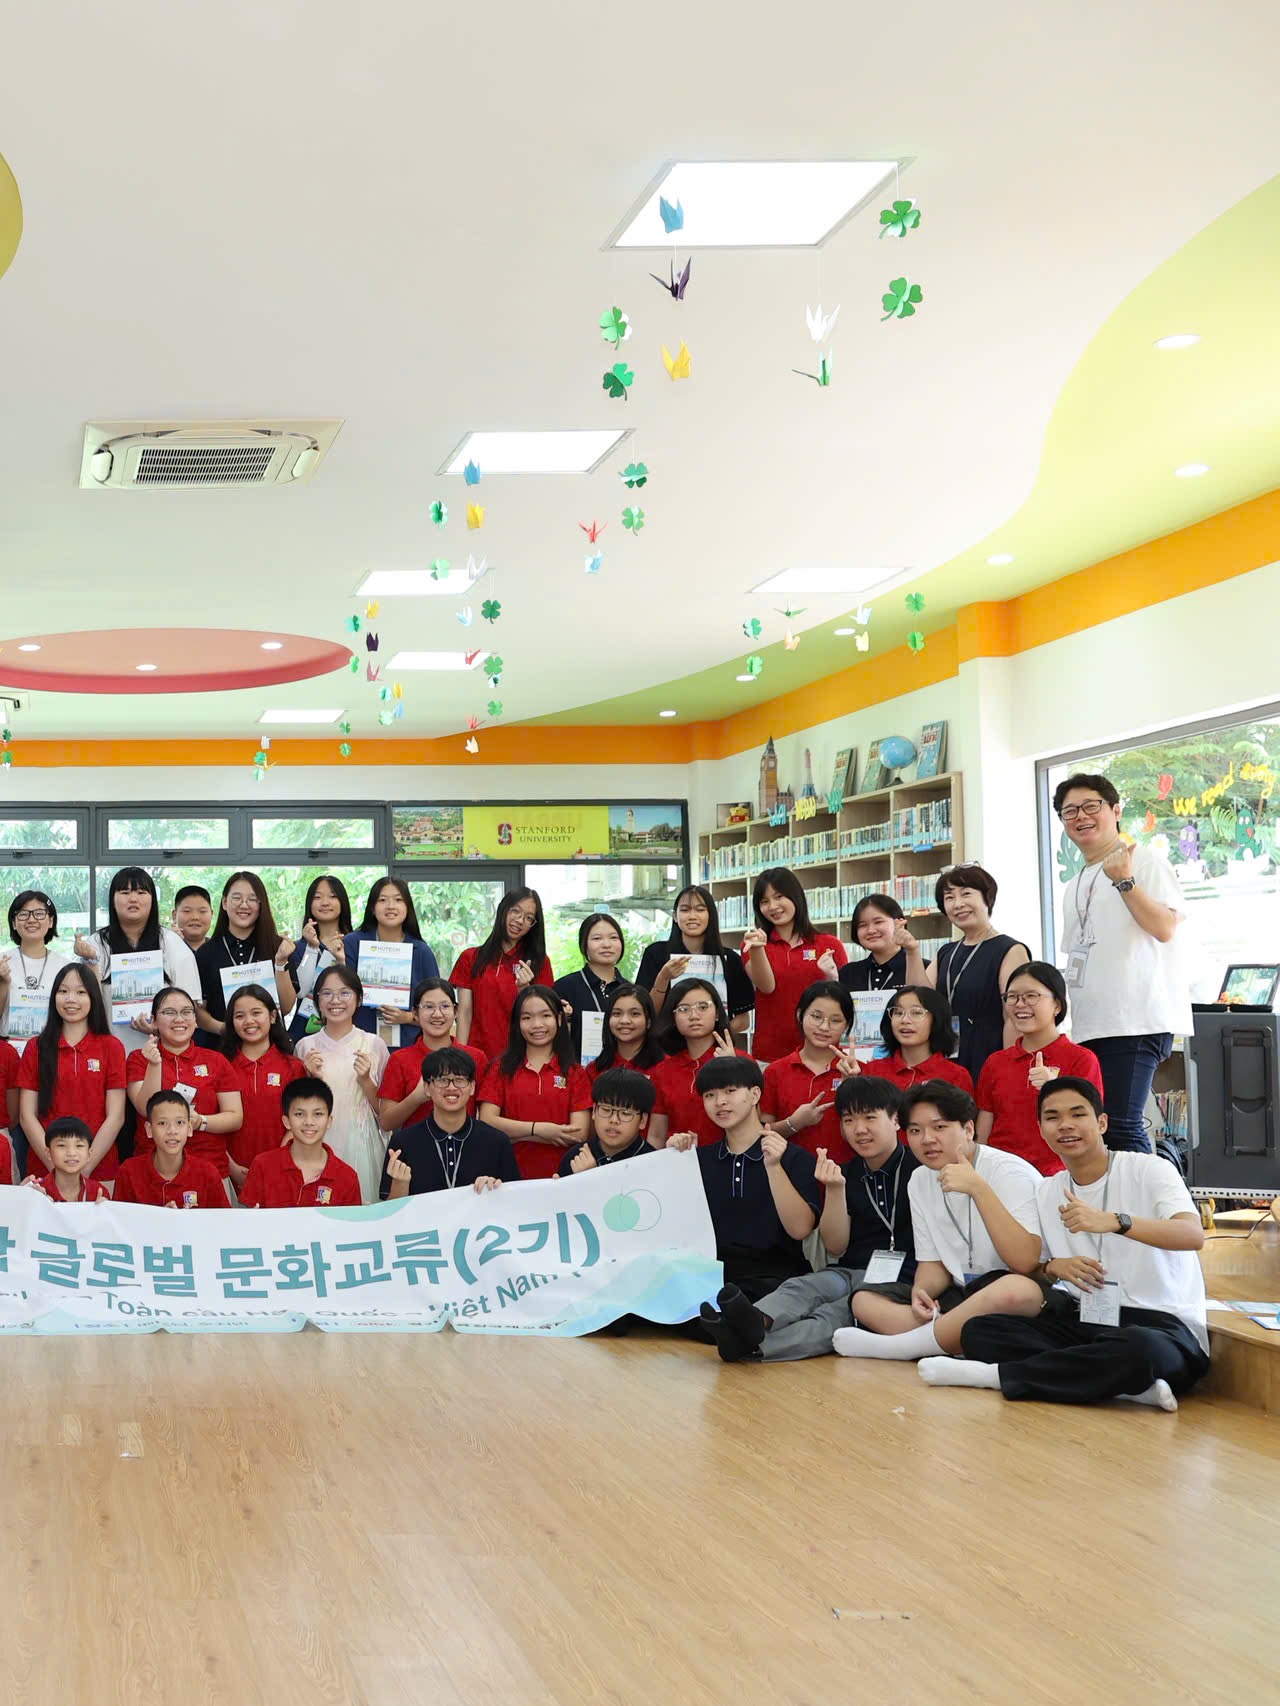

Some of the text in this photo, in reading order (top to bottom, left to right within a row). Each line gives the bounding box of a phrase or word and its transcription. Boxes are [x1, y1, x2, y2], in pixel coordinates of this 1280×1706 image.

[515, 826, 575, 834] STANFORD
[30, 1231, 198, 1298] 글로벌
[215, 1211, 600, 1299] 문화교류(2기)
